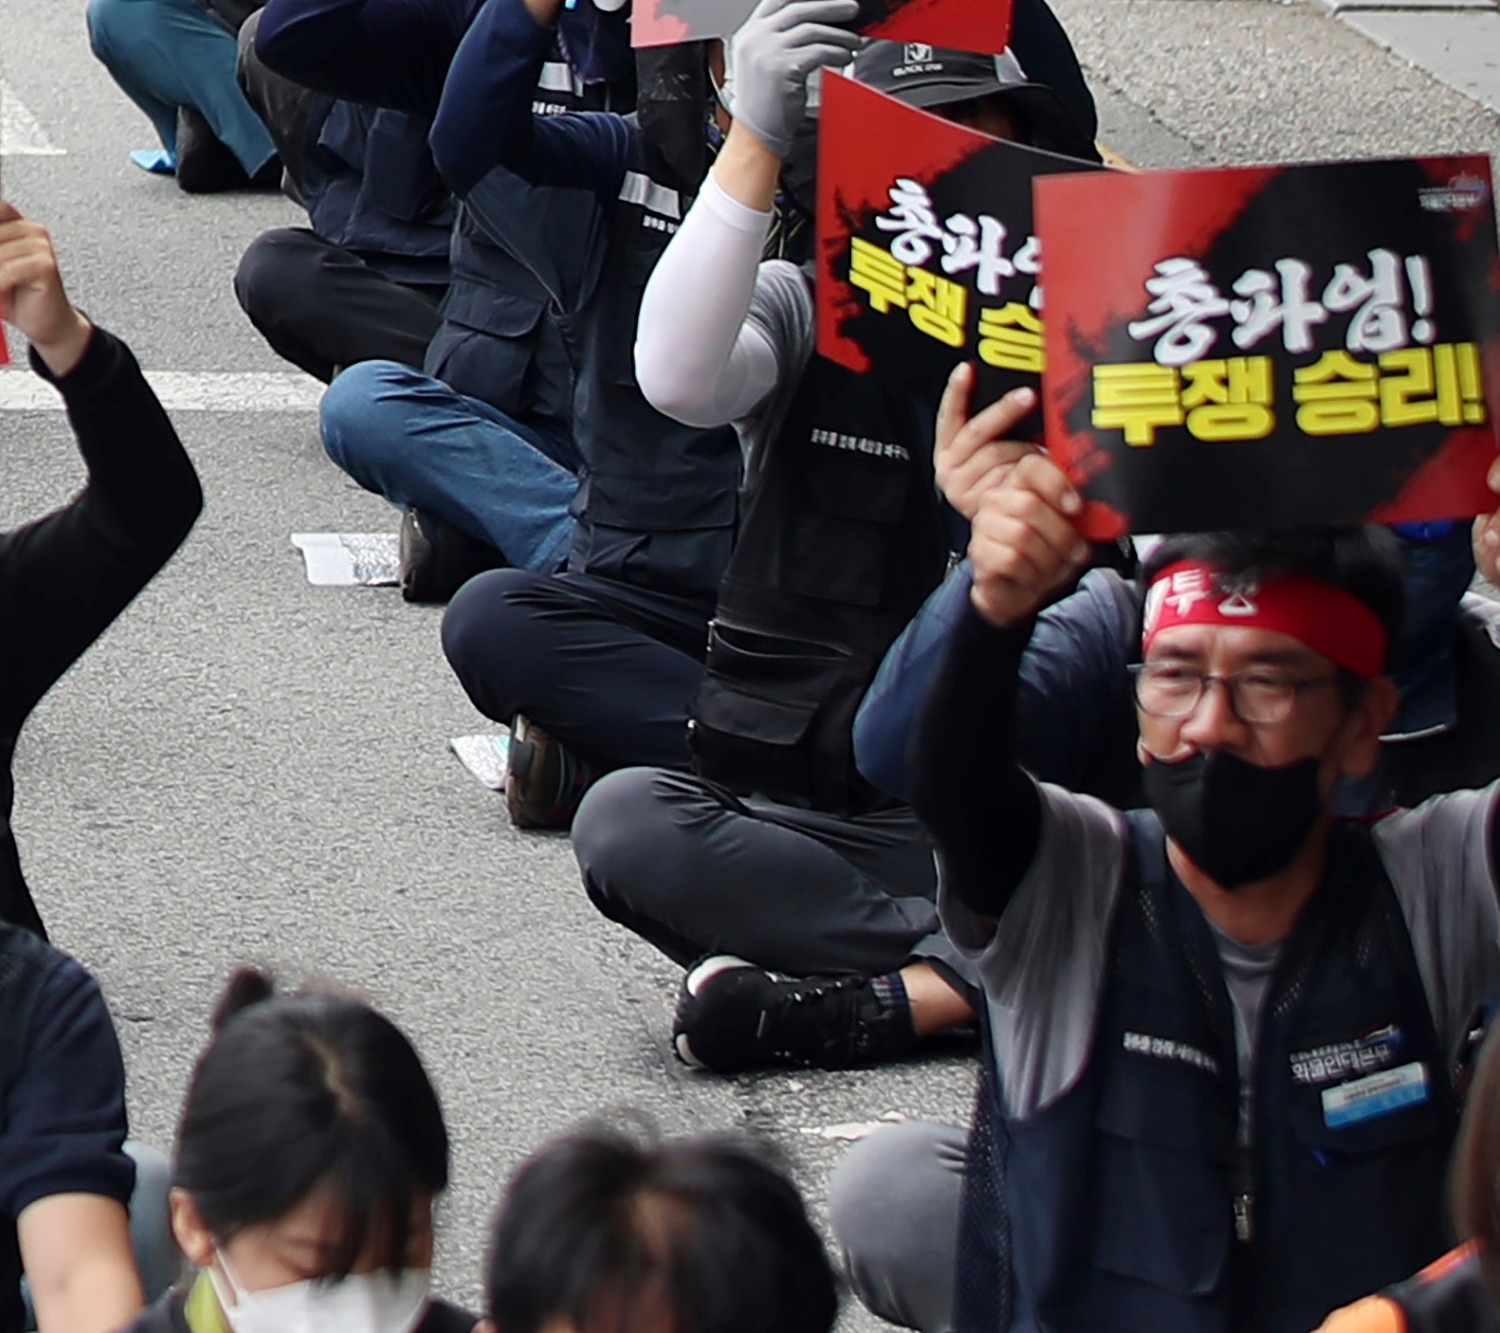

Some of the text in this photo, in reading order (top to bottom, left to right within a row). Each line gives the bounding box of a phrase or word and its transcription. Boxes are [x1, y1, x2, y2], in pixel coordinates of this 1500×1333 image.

[850, 238, 966, 346] 투쟁
[1129, 252, 1429, 363] 총파업!
[1092, 344, 1483, 445] 투쟁 승리!
[1291, 1045, 1390, 1083] 화물연대본부
